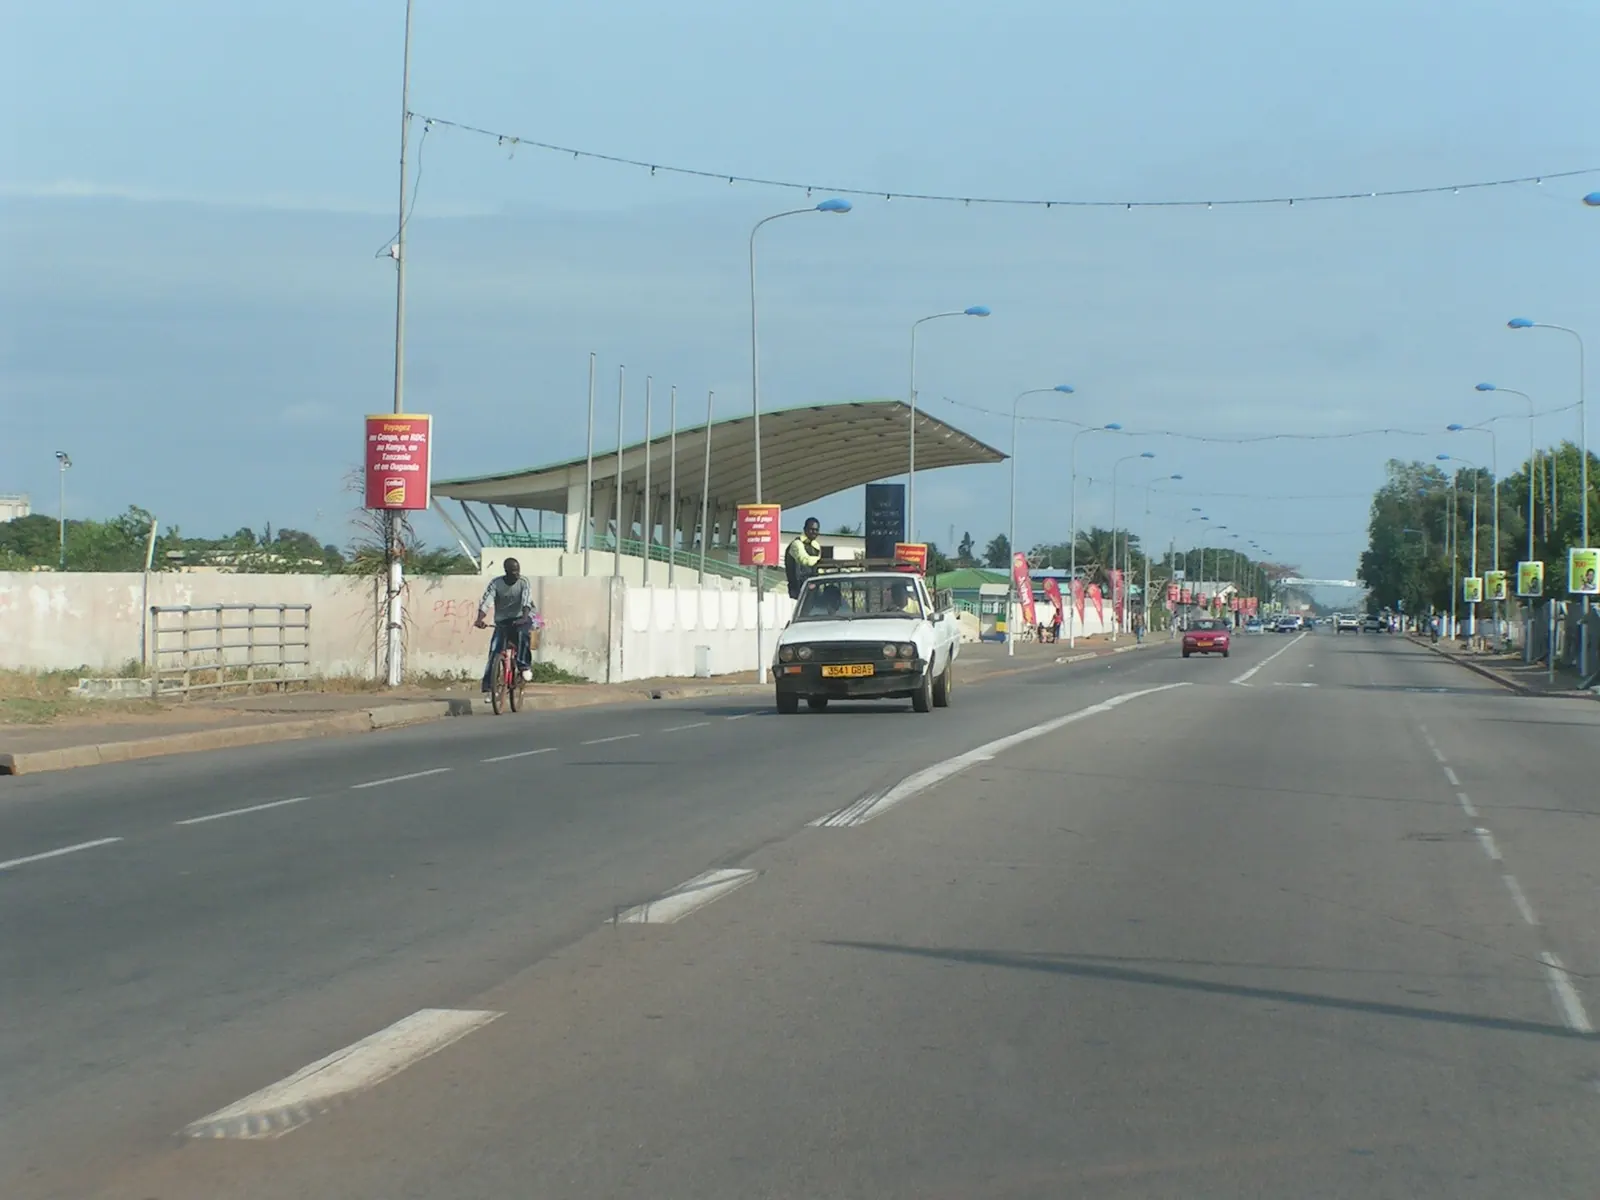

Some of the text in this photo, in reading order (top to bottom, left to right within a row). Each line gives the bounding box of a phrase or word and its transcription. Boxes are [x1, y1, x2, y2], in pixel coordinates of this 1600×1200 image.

[384, 424, 411, 433] Voyagez
[382, 453, 411, 461] Tanzanie
[828, 666, 849, 675] 3541
